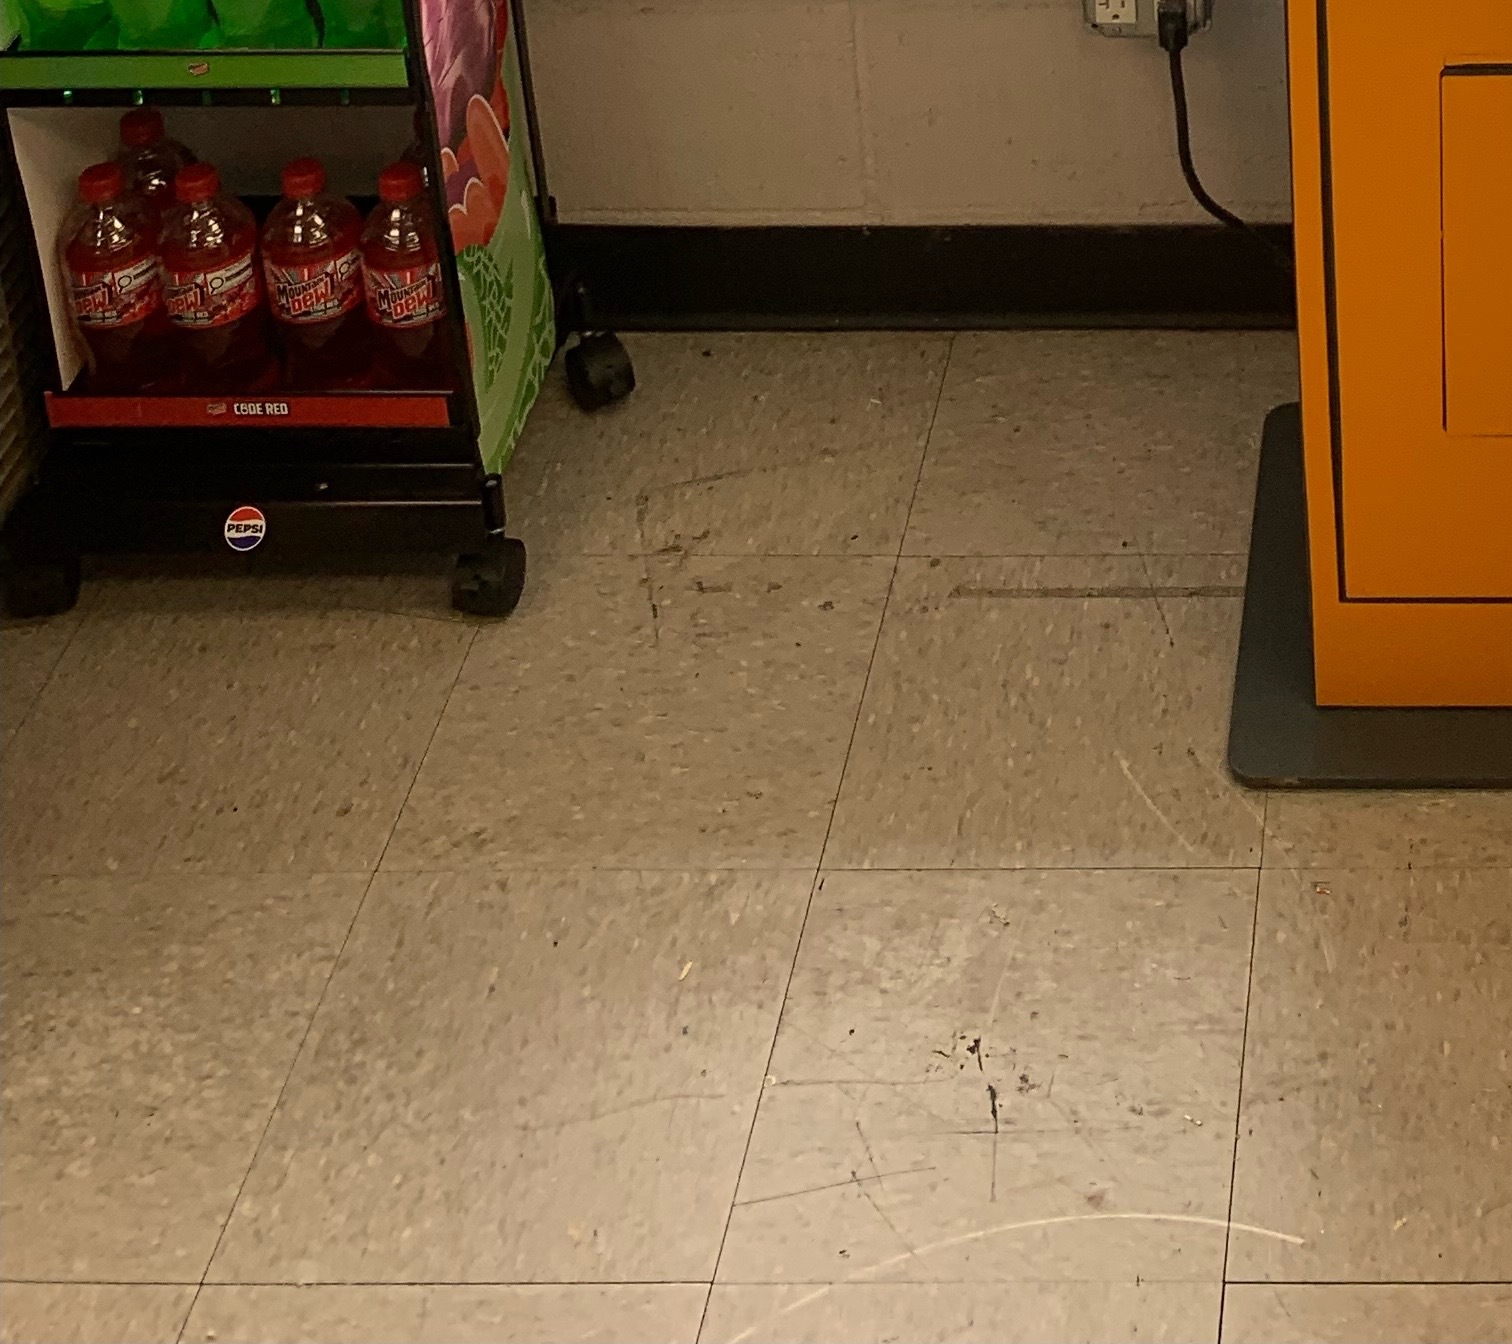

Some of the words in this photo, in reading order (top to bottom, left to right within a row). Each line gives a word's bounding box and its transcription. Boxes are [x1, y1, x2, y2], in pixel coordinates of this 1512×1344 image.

[233, 402, 263, 415] CODE
[265, 402, 289, 415] RED
[227, 523, 264, 534] PEPSI
